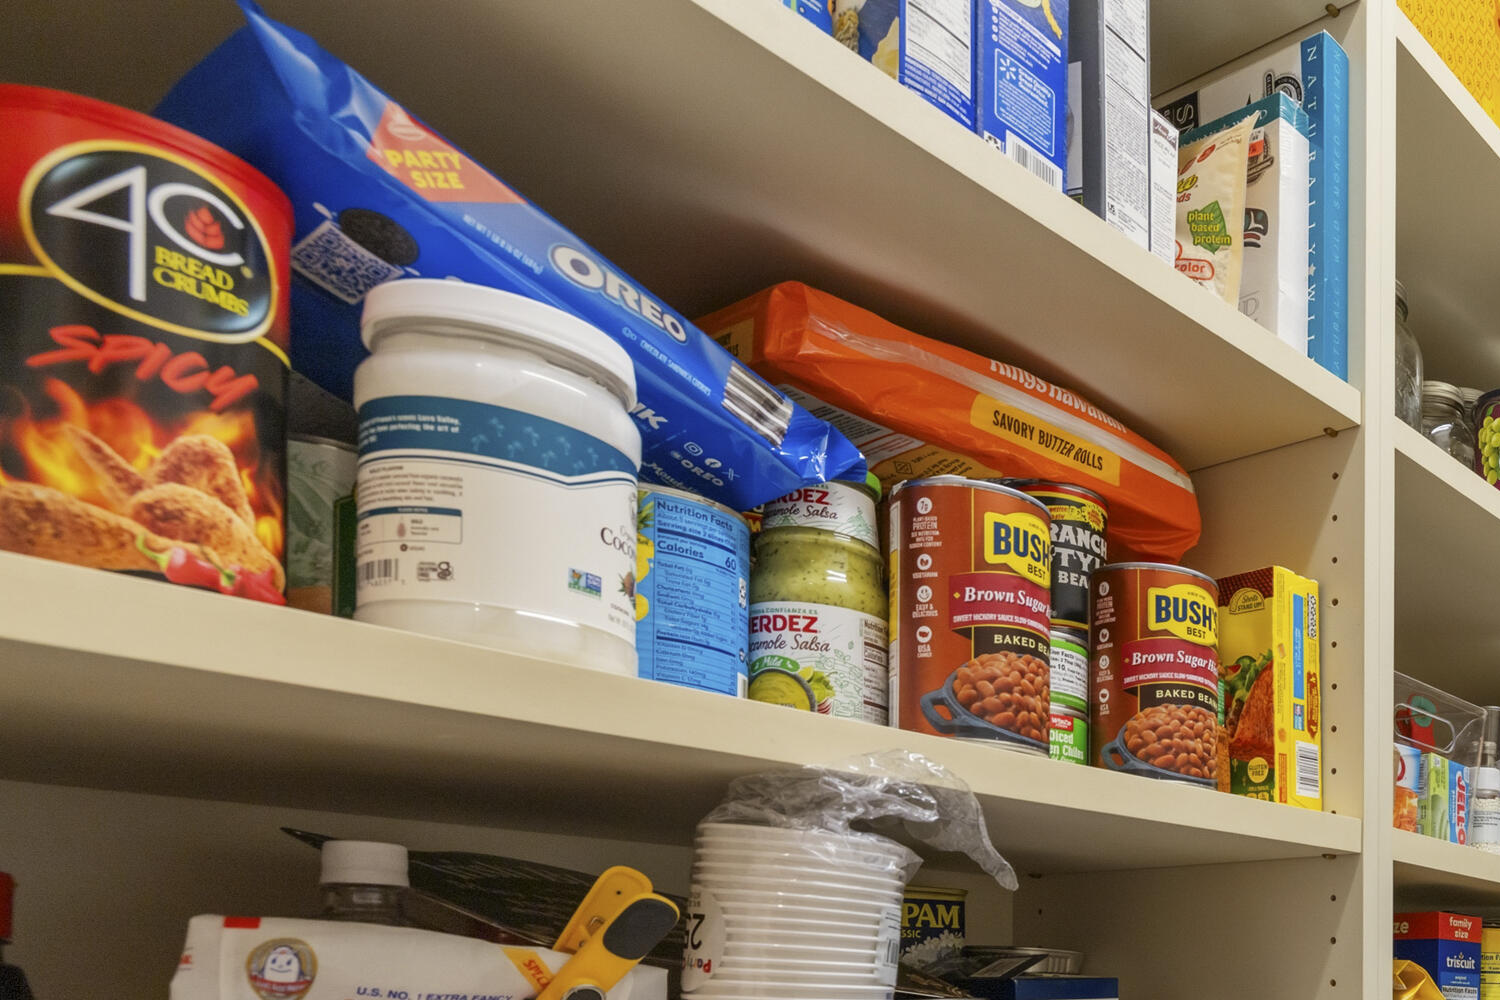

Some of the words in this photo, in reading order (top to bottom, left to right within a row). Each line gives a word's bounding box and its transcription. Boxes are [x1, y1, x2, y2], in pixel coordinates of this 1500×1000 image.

[385, 149, 462, 170] PARTY
[410, 171, 465, 190] SIZE
[1188, 211, 1214, 222] plant
[1191, 222, 1220, 233] based
[1193, 234, 1232, 248] protein
[154, 245, 234, 290] BREAD
[152, 266, 249, 317] CRUMBS
[552, 245, 688, 343] OREO
[992, 409, 1035, 441] SAVORY
[1038, 429, 1073, 457] BUTTER
[1073, 447, 1103, 471] ROLLS
[656, 501, 708, 522] Nutrition
[711, 515, 733, 531] Facts
[803, 505, 839, 520] Salsa
[913, 521, 938, 531] PROTEIN
[657, 540, 704, 558] Calories
[725, 557, 736, 570] 60
[1027, 564, 1046, 581] BEST
[964, 587, 1014, 604] Brown
[1017, 590, 1046, 613] Sugar
[912, 610, 938, 619] DELICIOUS
[1186, 626, 1206, 640] BEST
[791, 634, 831, 652] Salsa
[994, 634, 1035, 648] BAKED
[762, 656, 782, 667] Mild
[1132, 652, 1174, 668] Brown
[1177, 650, 1207, 669] Sugar
[1156, 689, 1195, 700] BAKED
[1248, 765, 1268, 773] GLUTEN
[1450, 917, 1472, 928] family
[1455, 930, 1468, 939] size
[1446, 955, 1475, 969] triscuit
[356, 986, 384, 999] U.S.
[387, 989, 412, 1000] NO.
